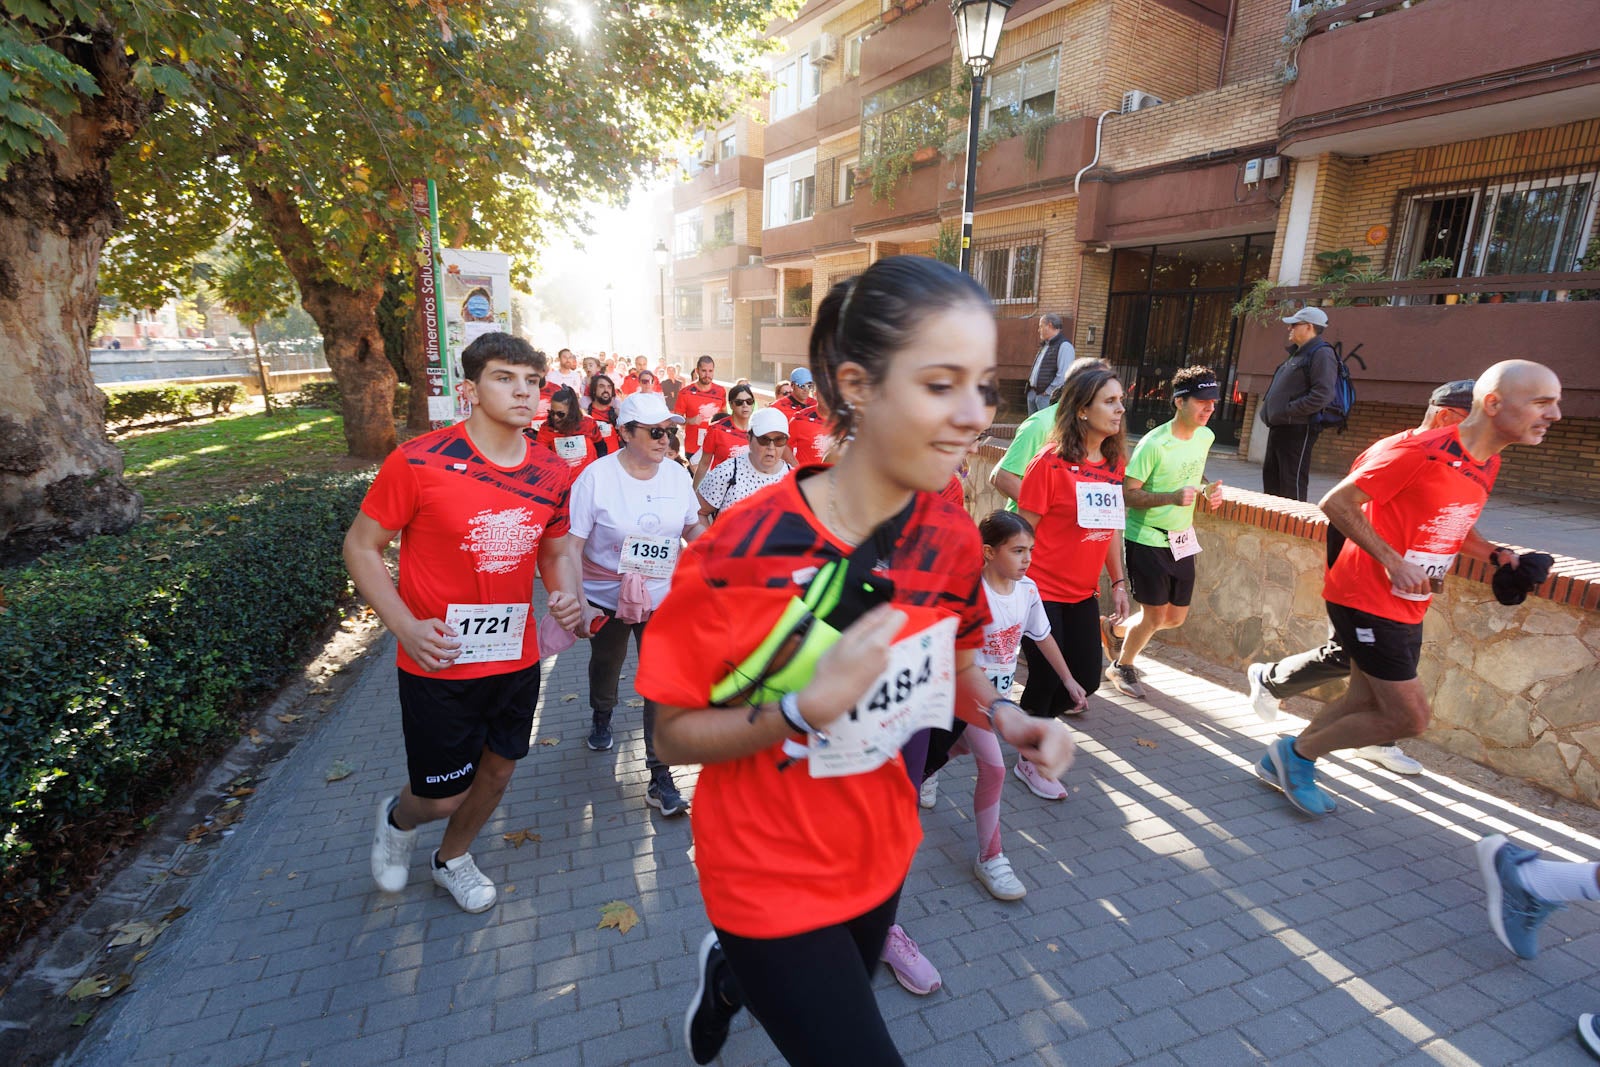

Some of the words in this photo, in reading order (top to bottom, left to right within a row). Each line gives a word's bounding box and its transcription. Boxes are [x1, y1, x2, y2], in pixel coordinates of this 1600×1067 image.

[1190, 274, 1198, 287] 2
[424, 297, 439, 359] tinerarios
[564, 441, 575, 449] 43
[1086, 493, 1117, 507] 1361
[471, 526, 537, 540] carrera
[631, 543, 669, 559] 1395
[460, 617, 510, 635] 1721
[426, 762, 473, 783] GIVOVA
